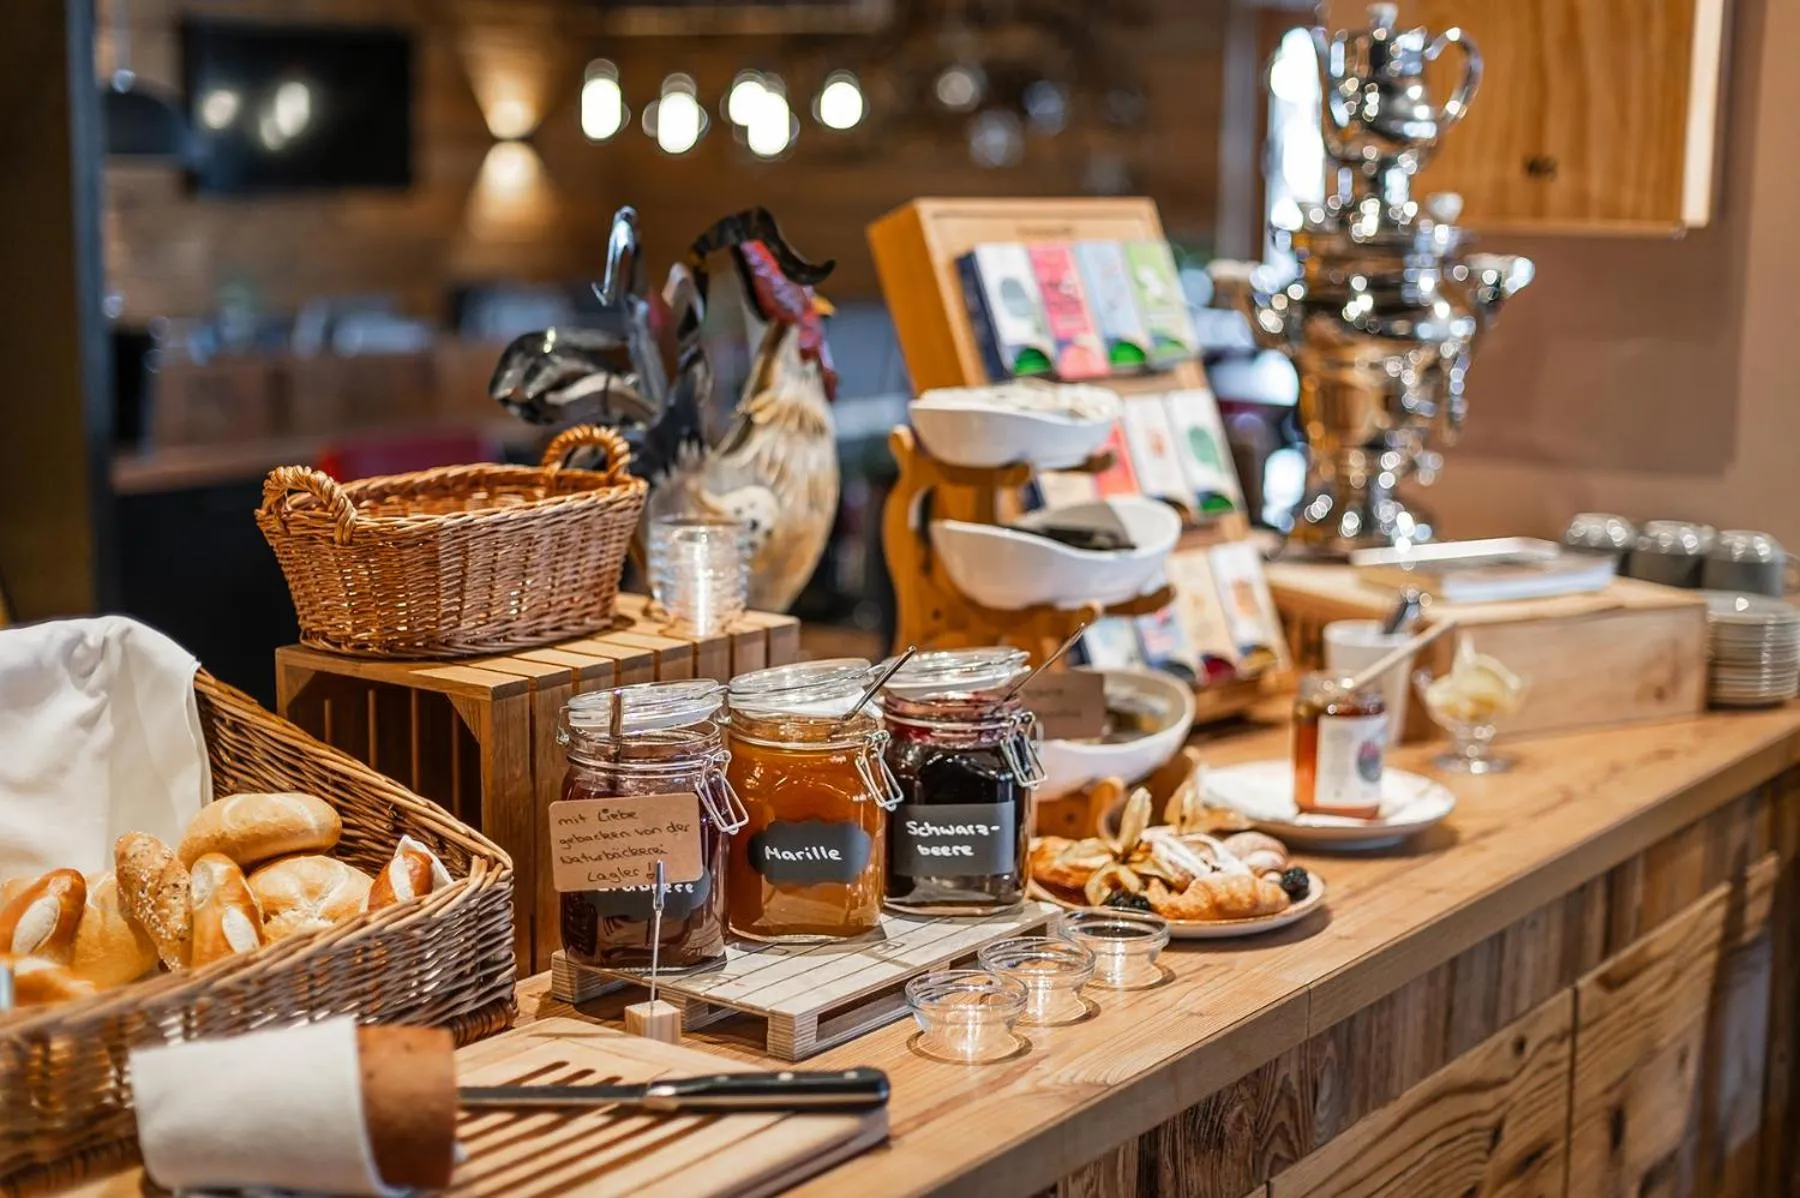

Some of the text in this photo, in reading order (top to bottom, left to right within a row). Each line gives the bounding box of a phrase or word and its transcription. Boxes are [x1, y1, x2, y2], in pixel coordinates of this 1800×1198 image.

[558, 808, 639, 825] mit Liebe
[559, 821, 690, 850] gebacken von der
[905, 820, 1000, 836] Schwarz-
[764, 845, 843, 861] Marille
[917, 844, 975, 857] beere
